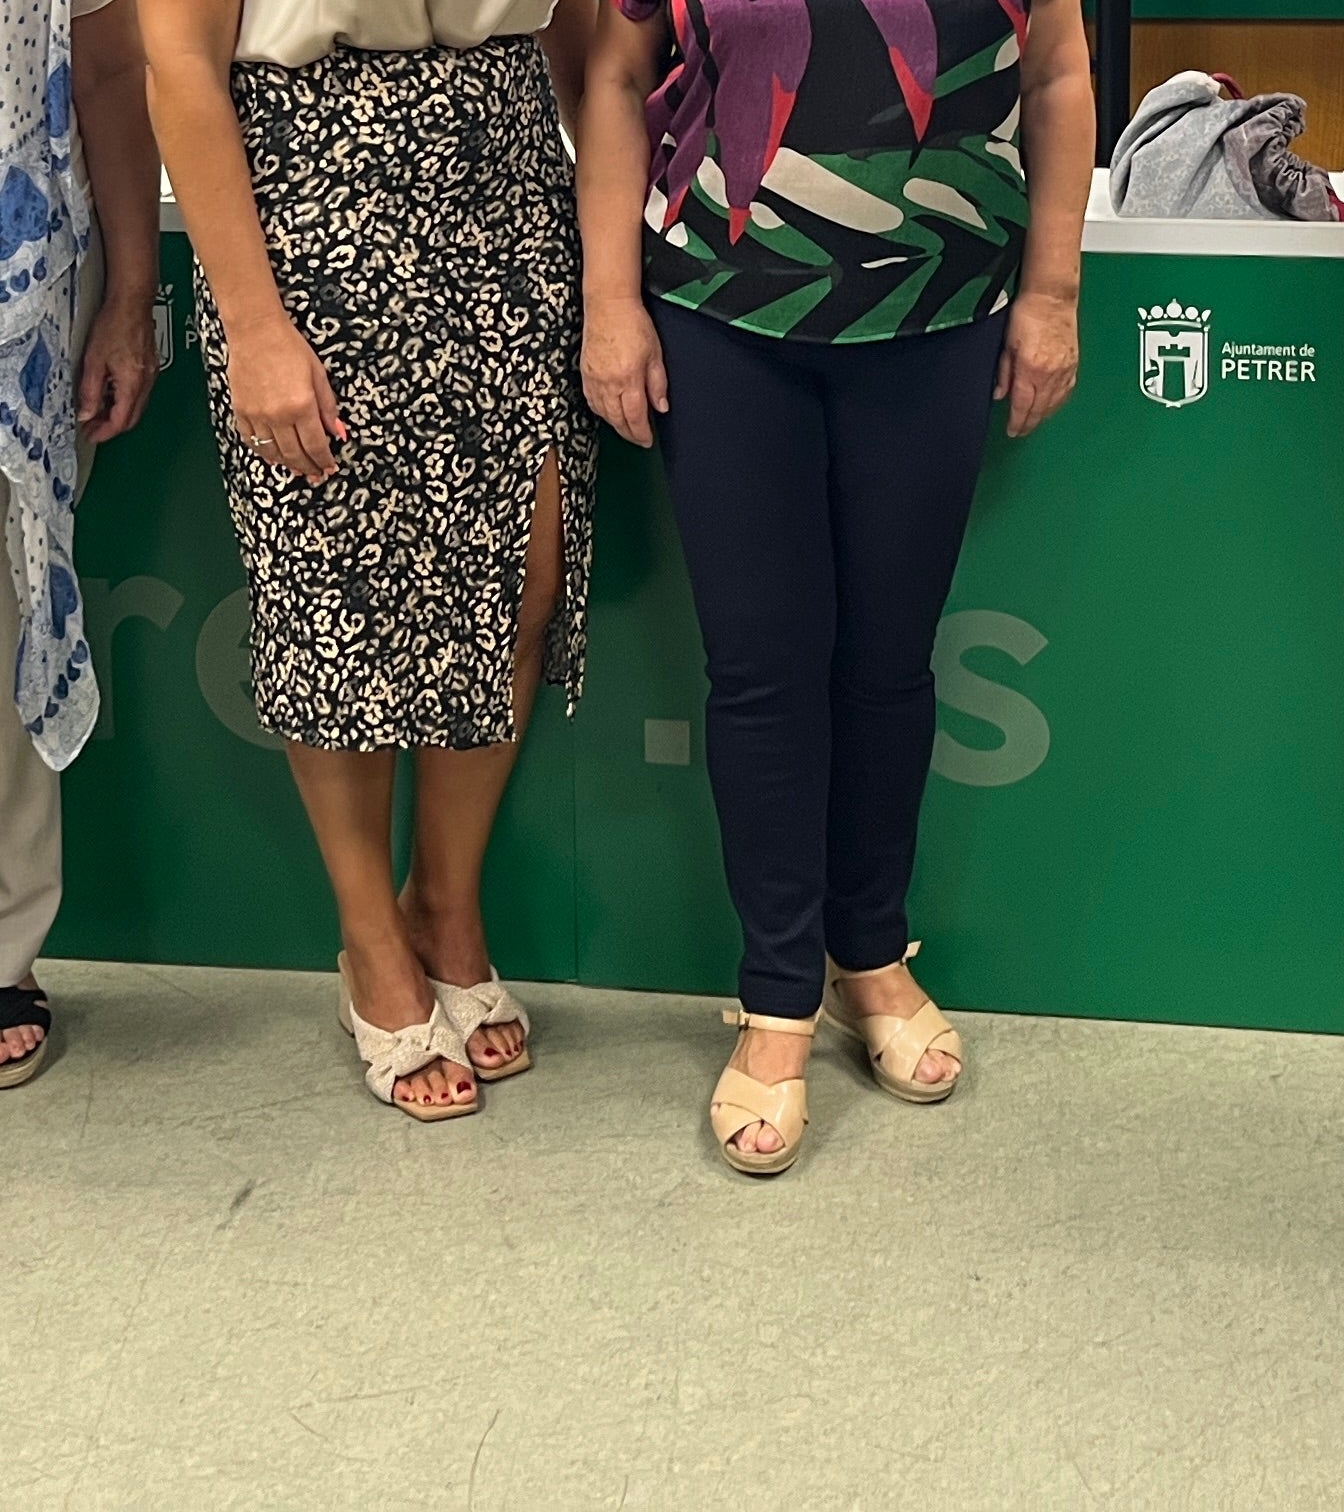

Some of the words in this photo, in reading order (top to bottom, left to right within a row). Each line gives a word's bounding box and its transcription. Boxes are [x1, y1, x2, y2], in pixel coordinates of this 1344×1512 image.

[1221, 341, 1297, 358] Ajuntament
[1299, 343, 1316, 358] de
[1221, 358, 1316, 382] PETRER
